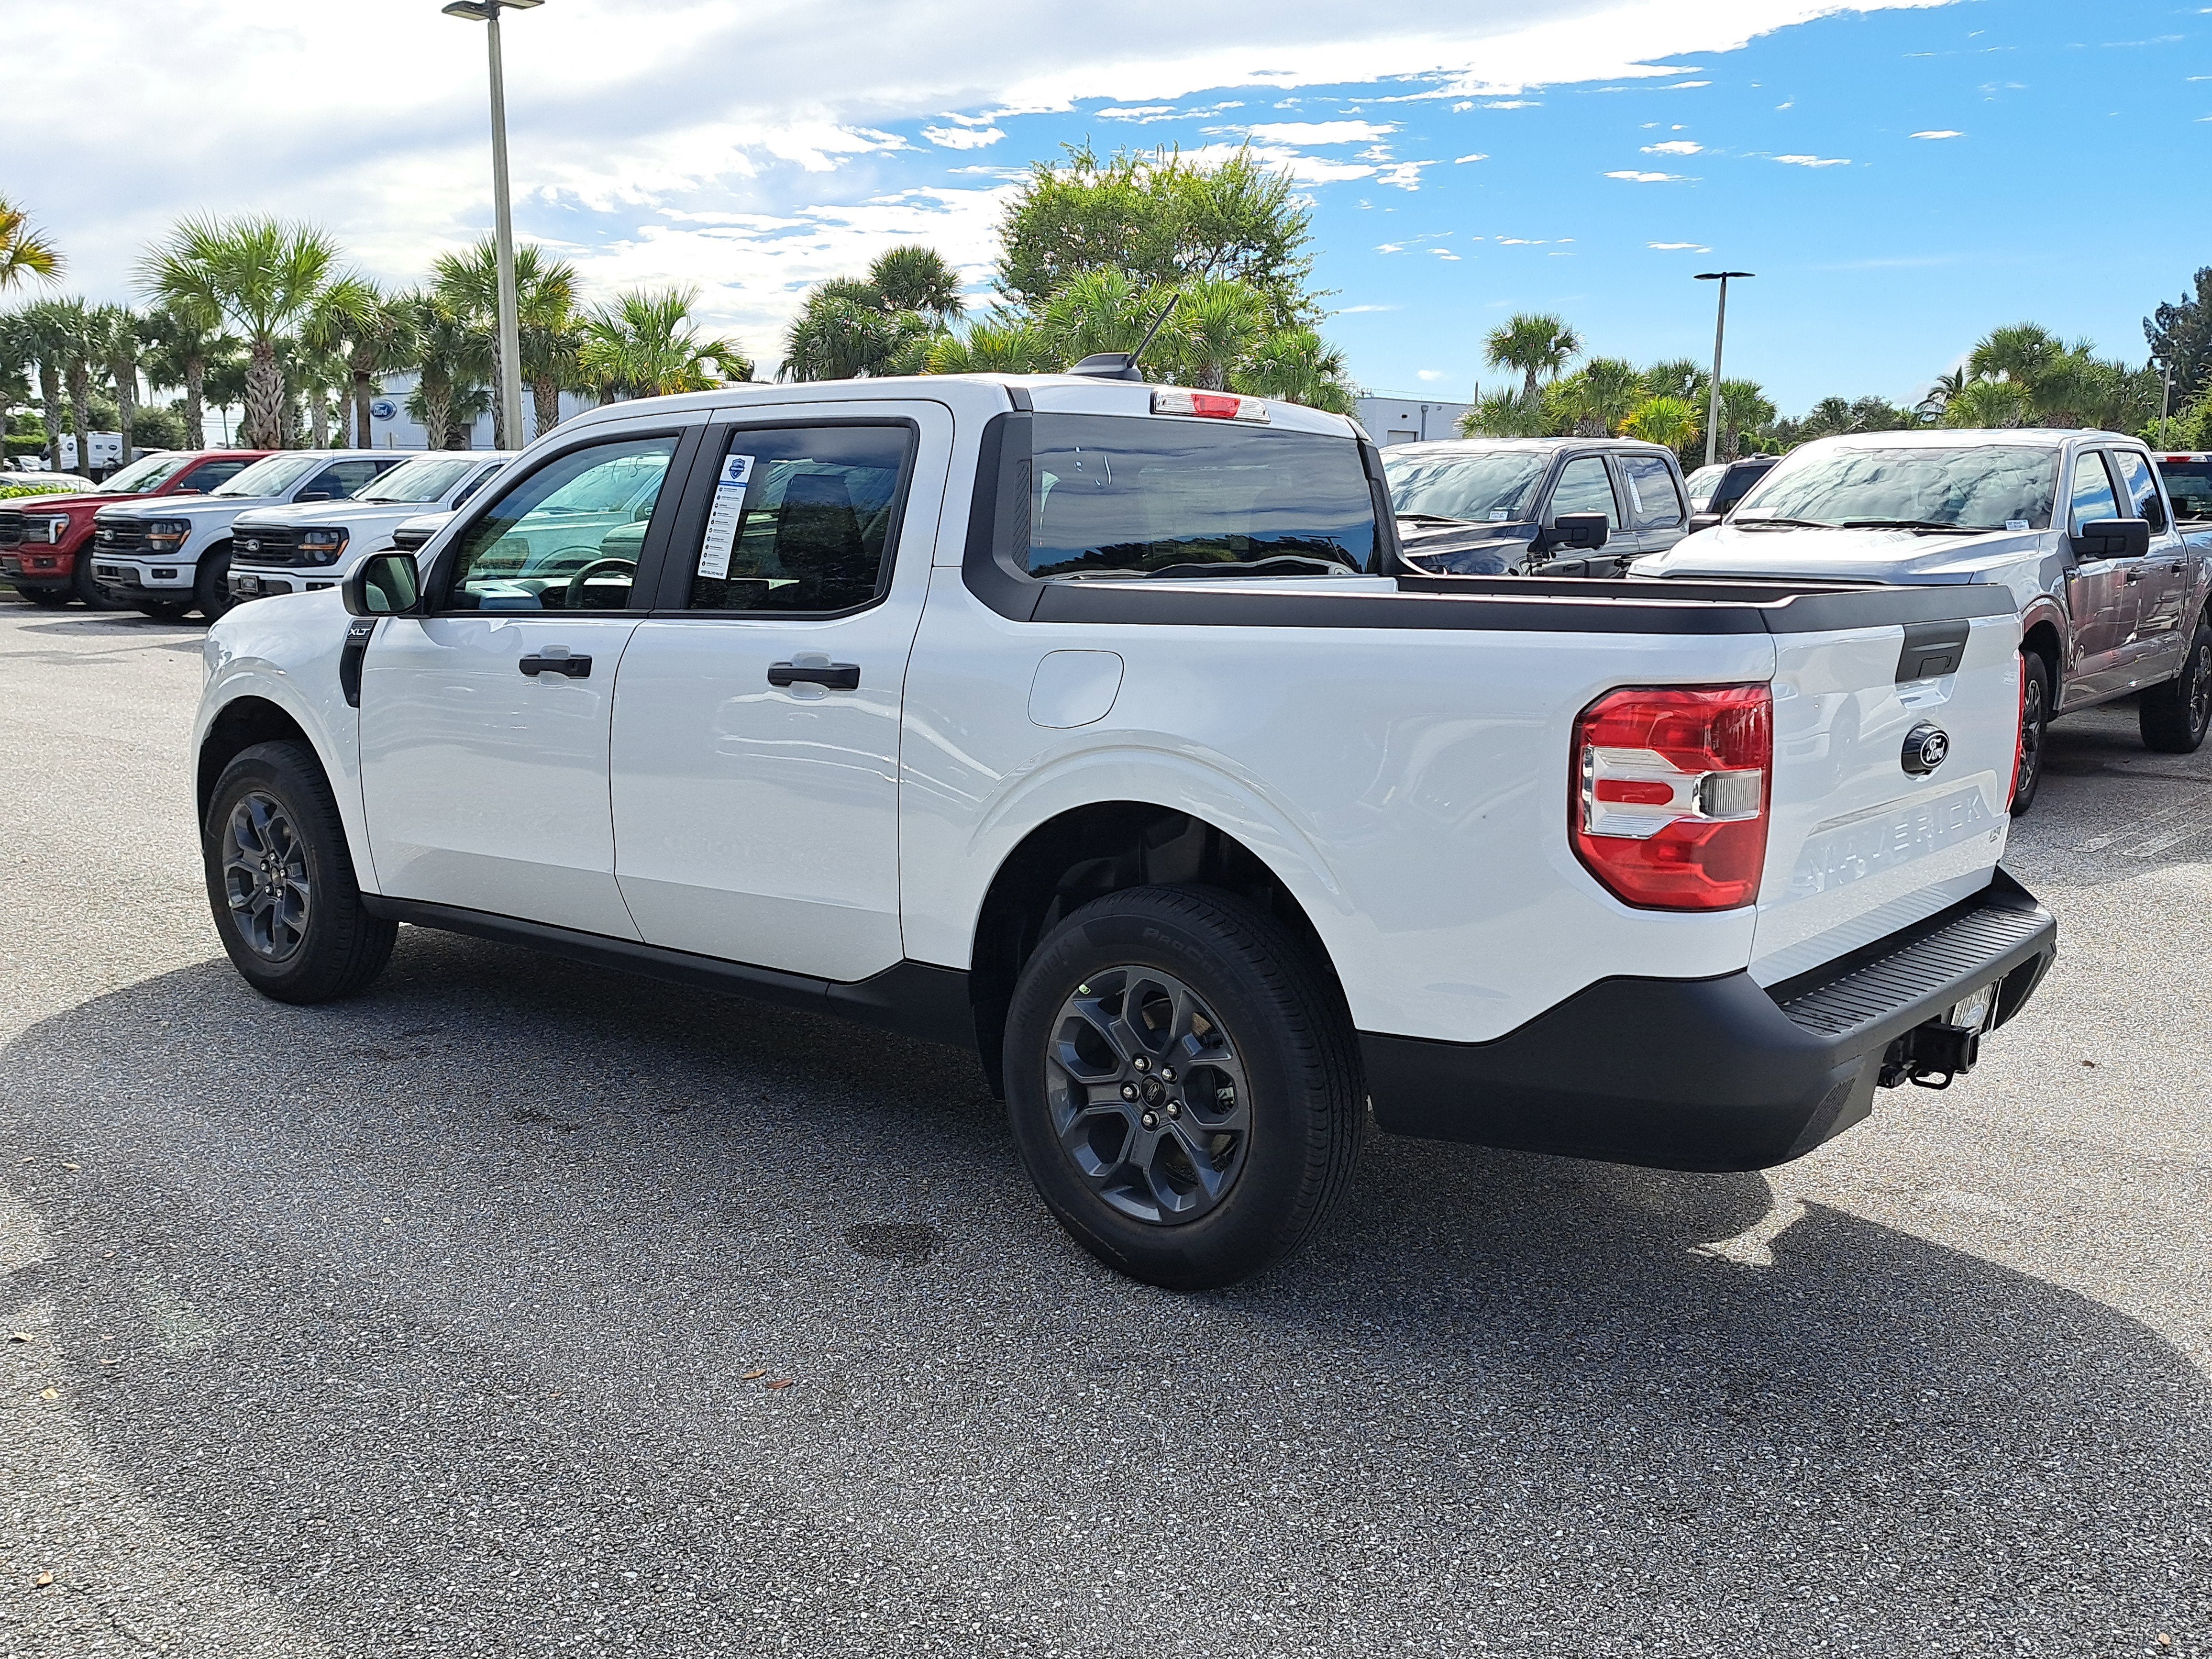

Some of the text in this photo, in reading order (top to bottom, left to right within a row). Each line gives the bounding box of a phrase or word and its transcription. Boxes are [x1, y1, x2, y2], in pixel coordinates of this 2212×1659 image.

[348, 628, 370, 636] XLT
[1926, 737, 1945, 762] Ford
[1806, 793, 1981, 881] MAVERICK
